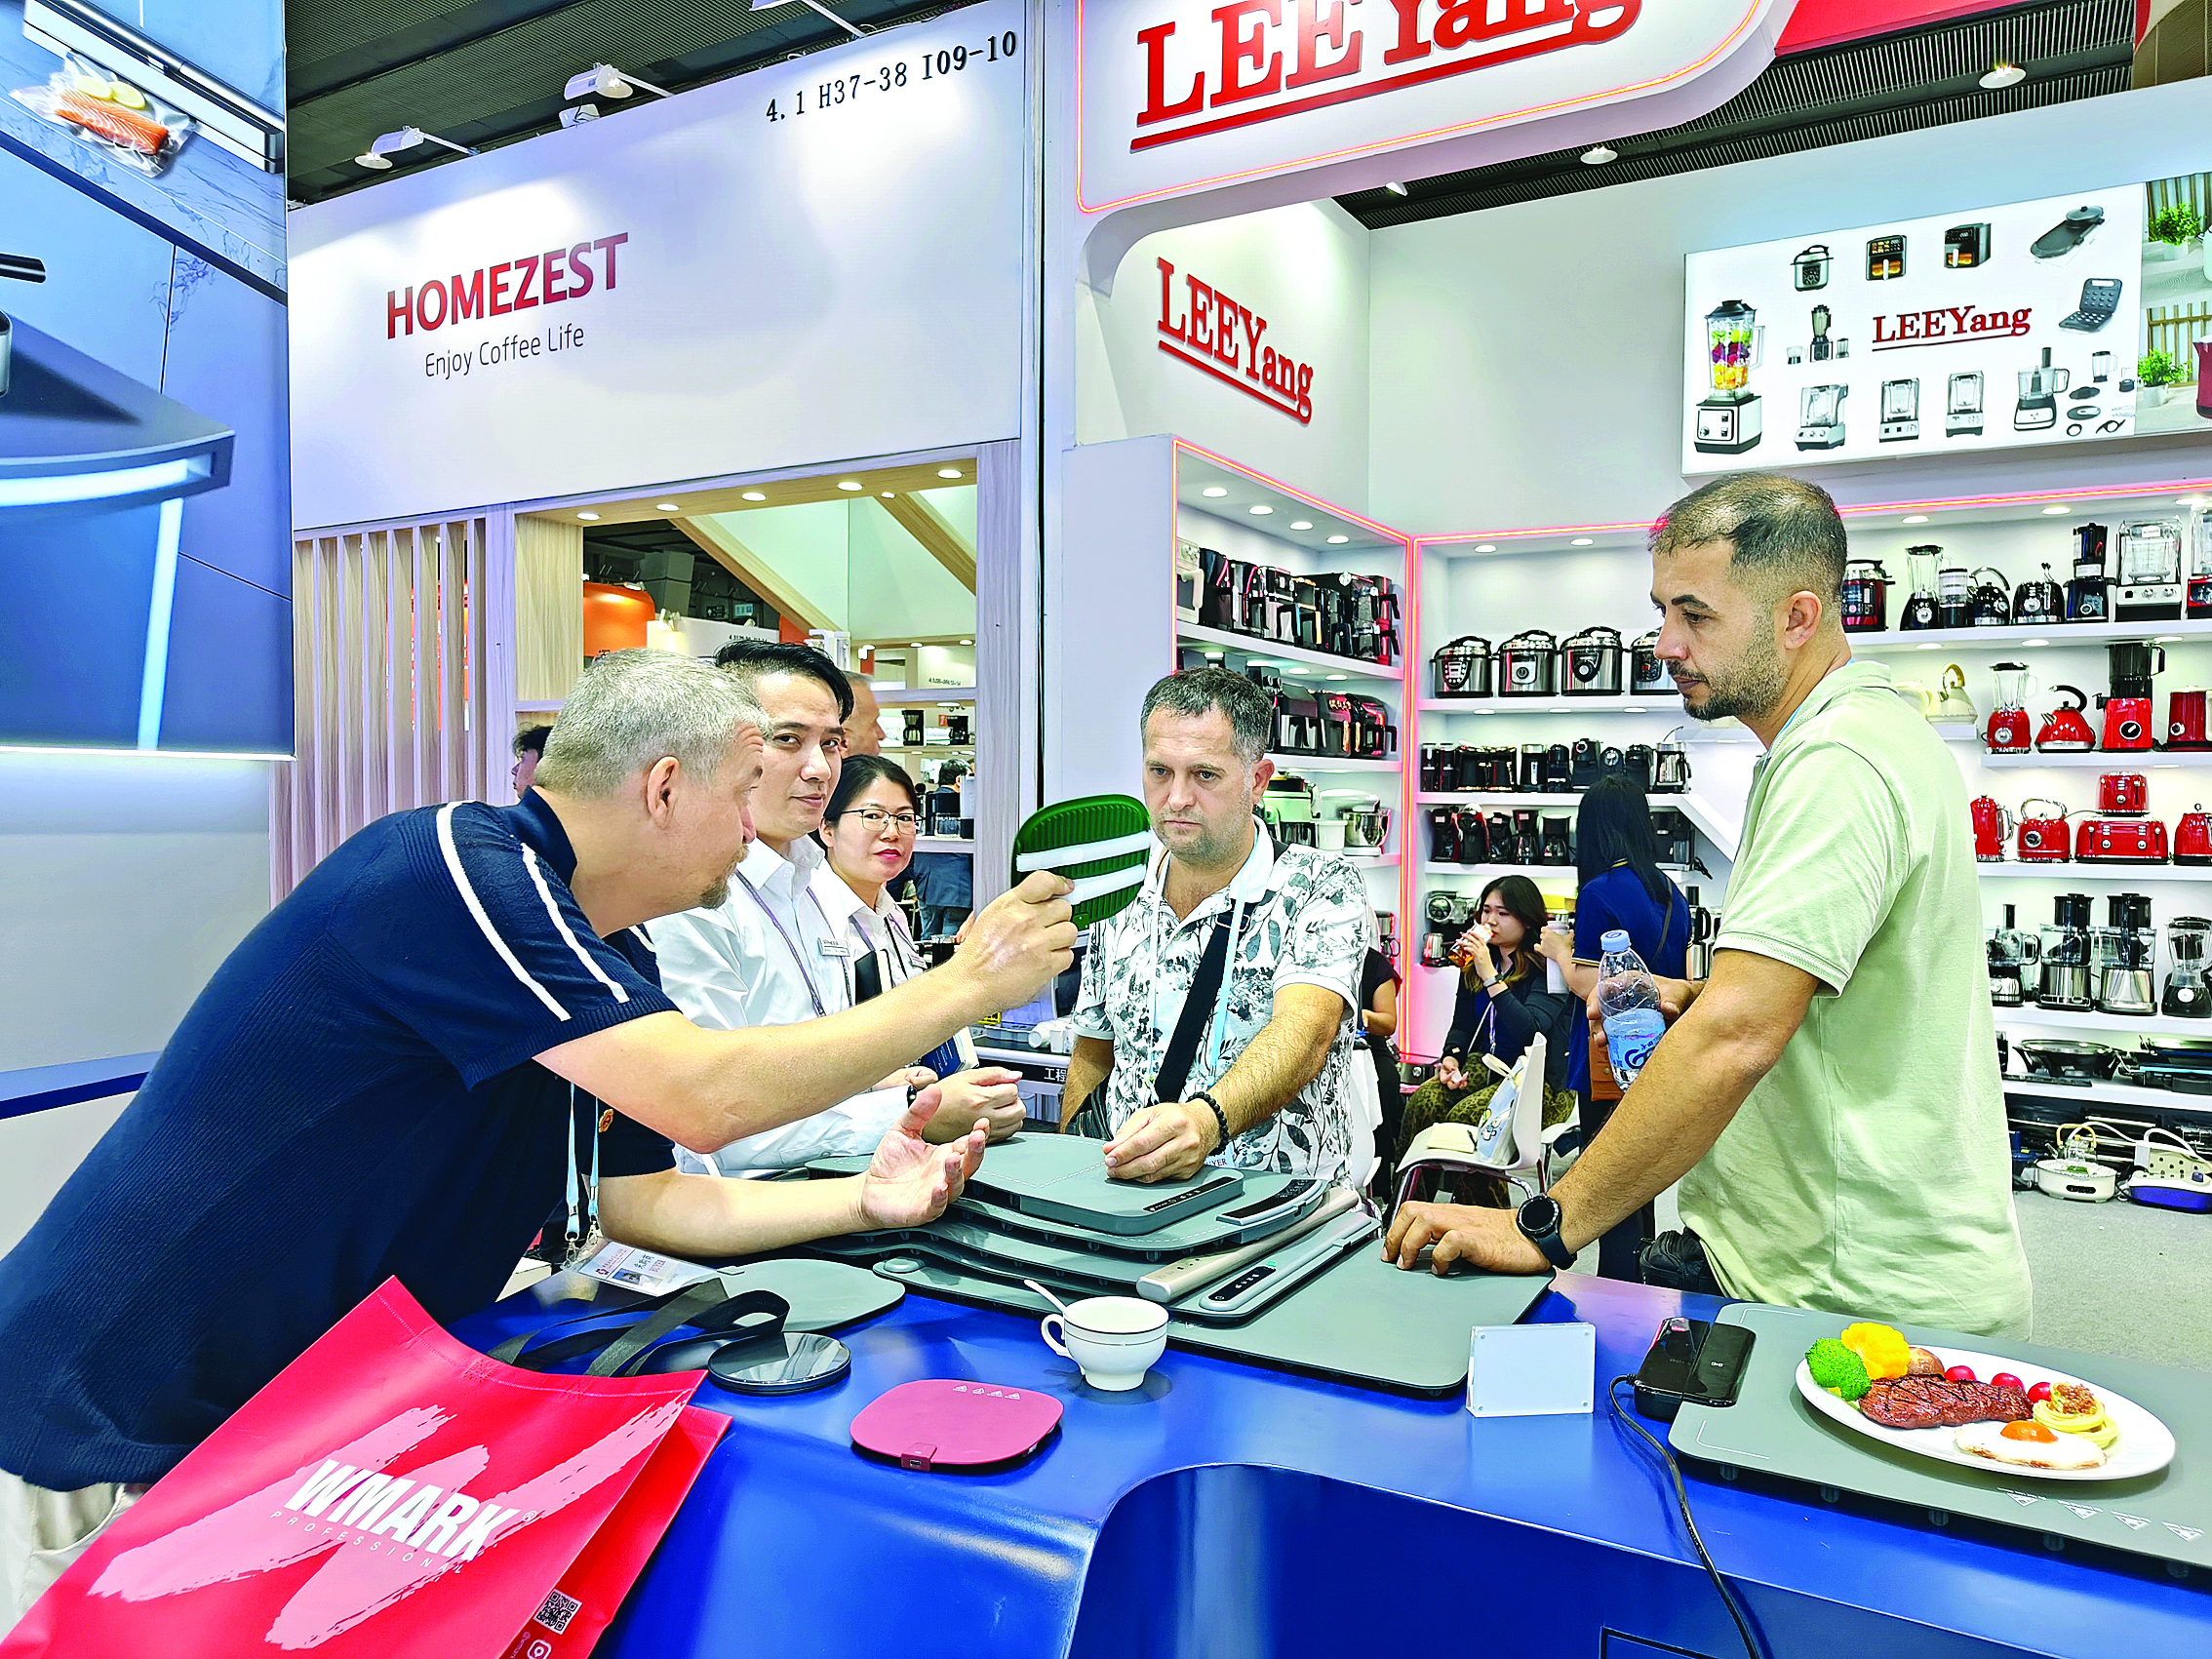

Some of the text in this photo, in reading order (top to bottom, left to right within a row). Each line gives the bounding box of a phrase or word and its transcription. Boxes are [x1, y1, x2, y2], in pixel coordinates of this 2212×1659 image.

[818, 61, 907, 109] H37-38
[922, 30, 1018, 81] I09-10
[387, 232, 629, 340] HOMEZEST
[425, 323, 585, 380] Enjoy Coffee Life
[1157, 257, 1314, 426] LEEYang
[1873, 305, 2032, 344] LEEYang
[1044, 1067, 1067, 1083] 工程
[270, 1511, 464, 1574] PROFESSIONAL
[283, 1458, 522, 1561] WMARK
